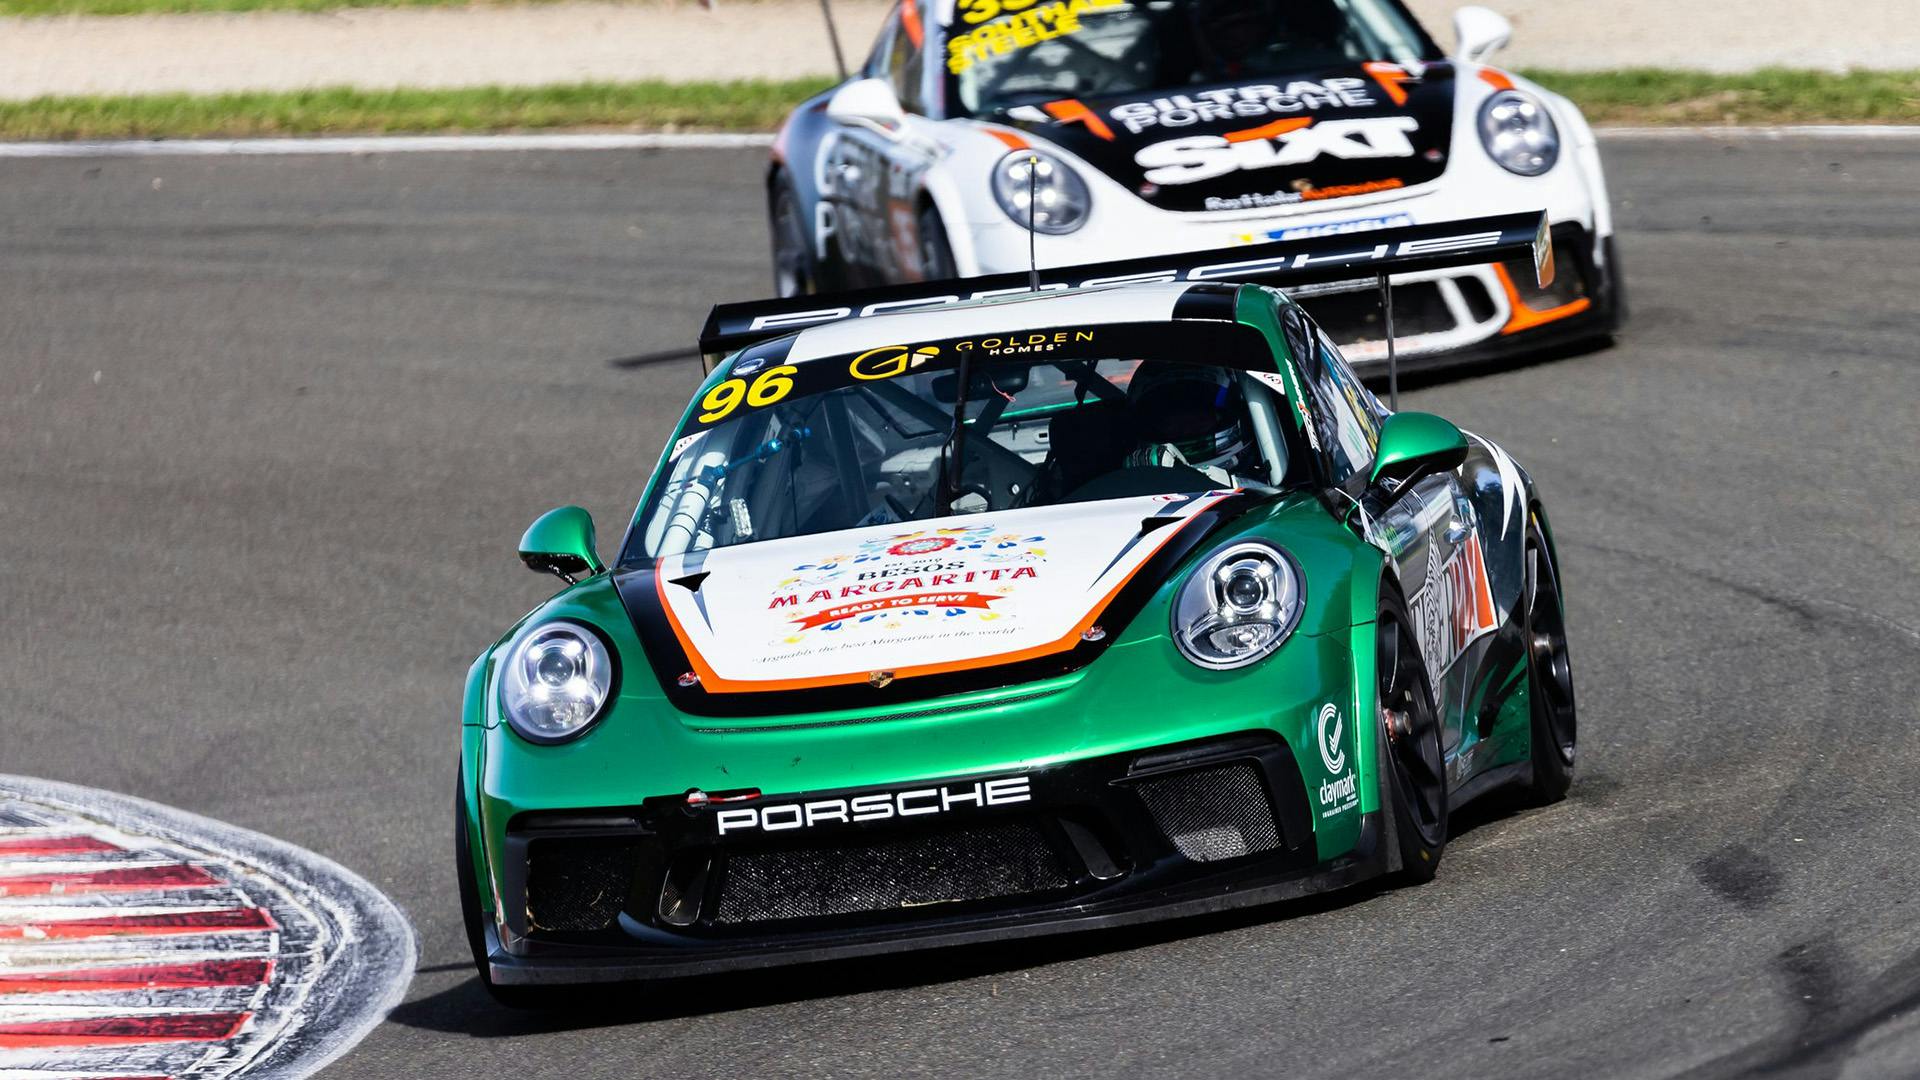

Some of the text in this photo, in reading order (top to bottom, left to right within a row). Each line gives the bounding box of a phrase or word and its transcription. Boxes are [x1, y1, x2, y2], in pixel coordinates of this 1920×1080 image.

[1109, 77, 1367, 121] GILTRAP
[1122, 89, 1377, 134] PORSCHE
[1134, 117, 1419, 184] SIXT
[955, 331, 1094, 351] GOLDEN
[989, 344, 1056, 356] HOMES
[698, 365, 798, 424] 96
[768, 566, 1038, 609] MARGARITA
[858, 561, 965, 581] BESOS
[829, 594, 968, 617] READY TO SERVE
[717, 776, 1031, 835] PORSCHE
[1320, 767, 1356, 807] claymark
